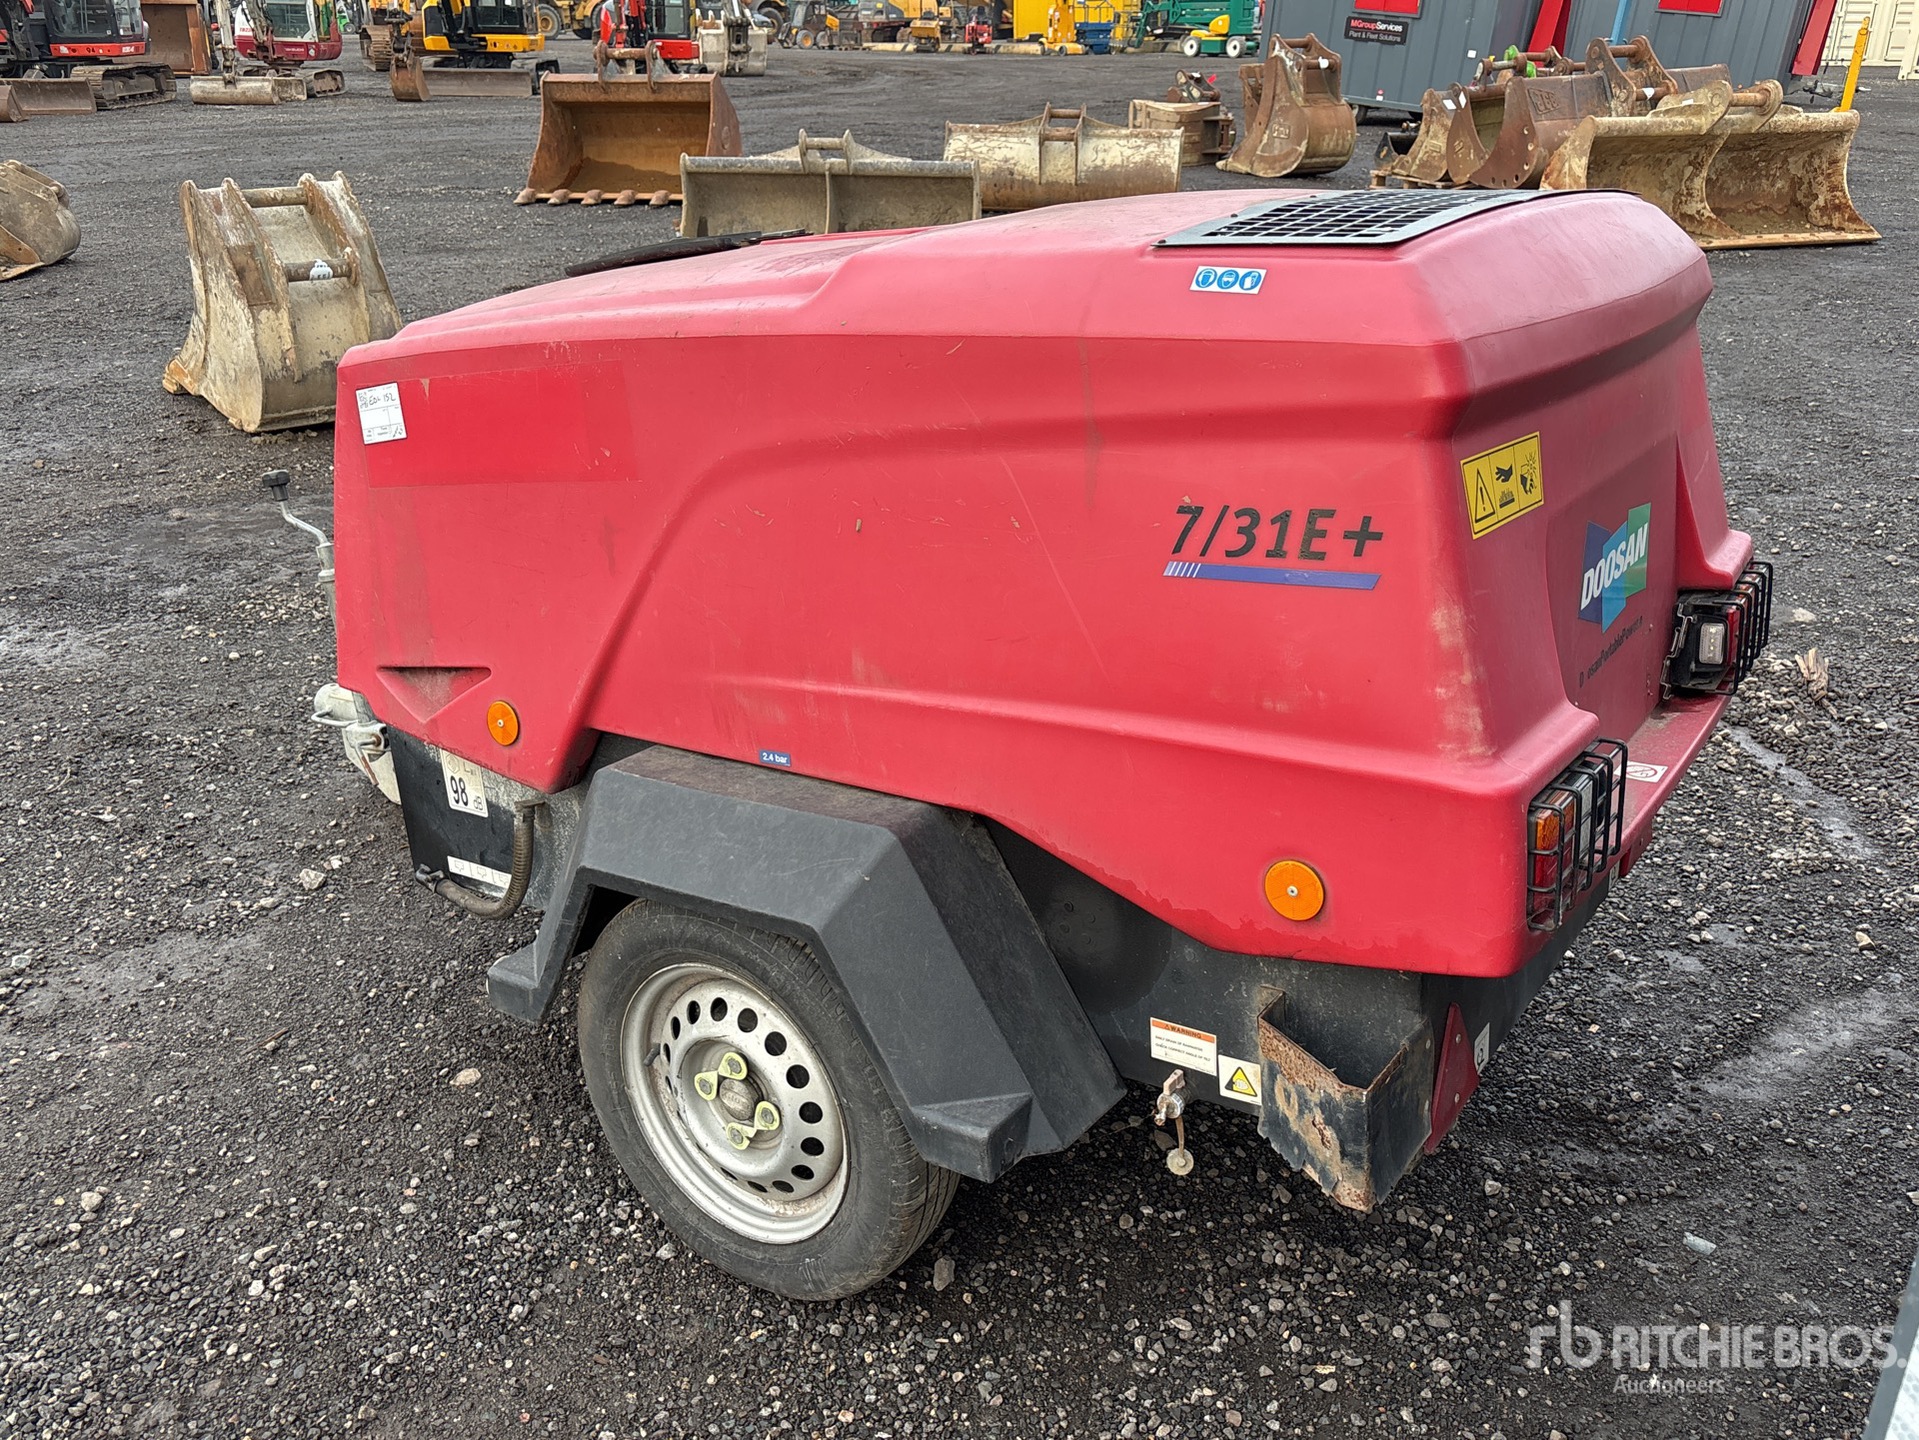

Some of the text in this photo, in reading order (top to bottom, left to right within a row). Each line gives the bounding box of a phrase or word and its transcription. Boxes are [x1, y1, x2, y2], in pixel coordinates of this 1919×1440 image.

[1171, 505, 1384, 561] 7/31E+
[1580, 522, 1649, 611] DOOSAN
[775, 754, 788, 763] bar
[450, 775, 483, 811] 98 dB
[1170, 1024, 1202, 1040] WARNING
